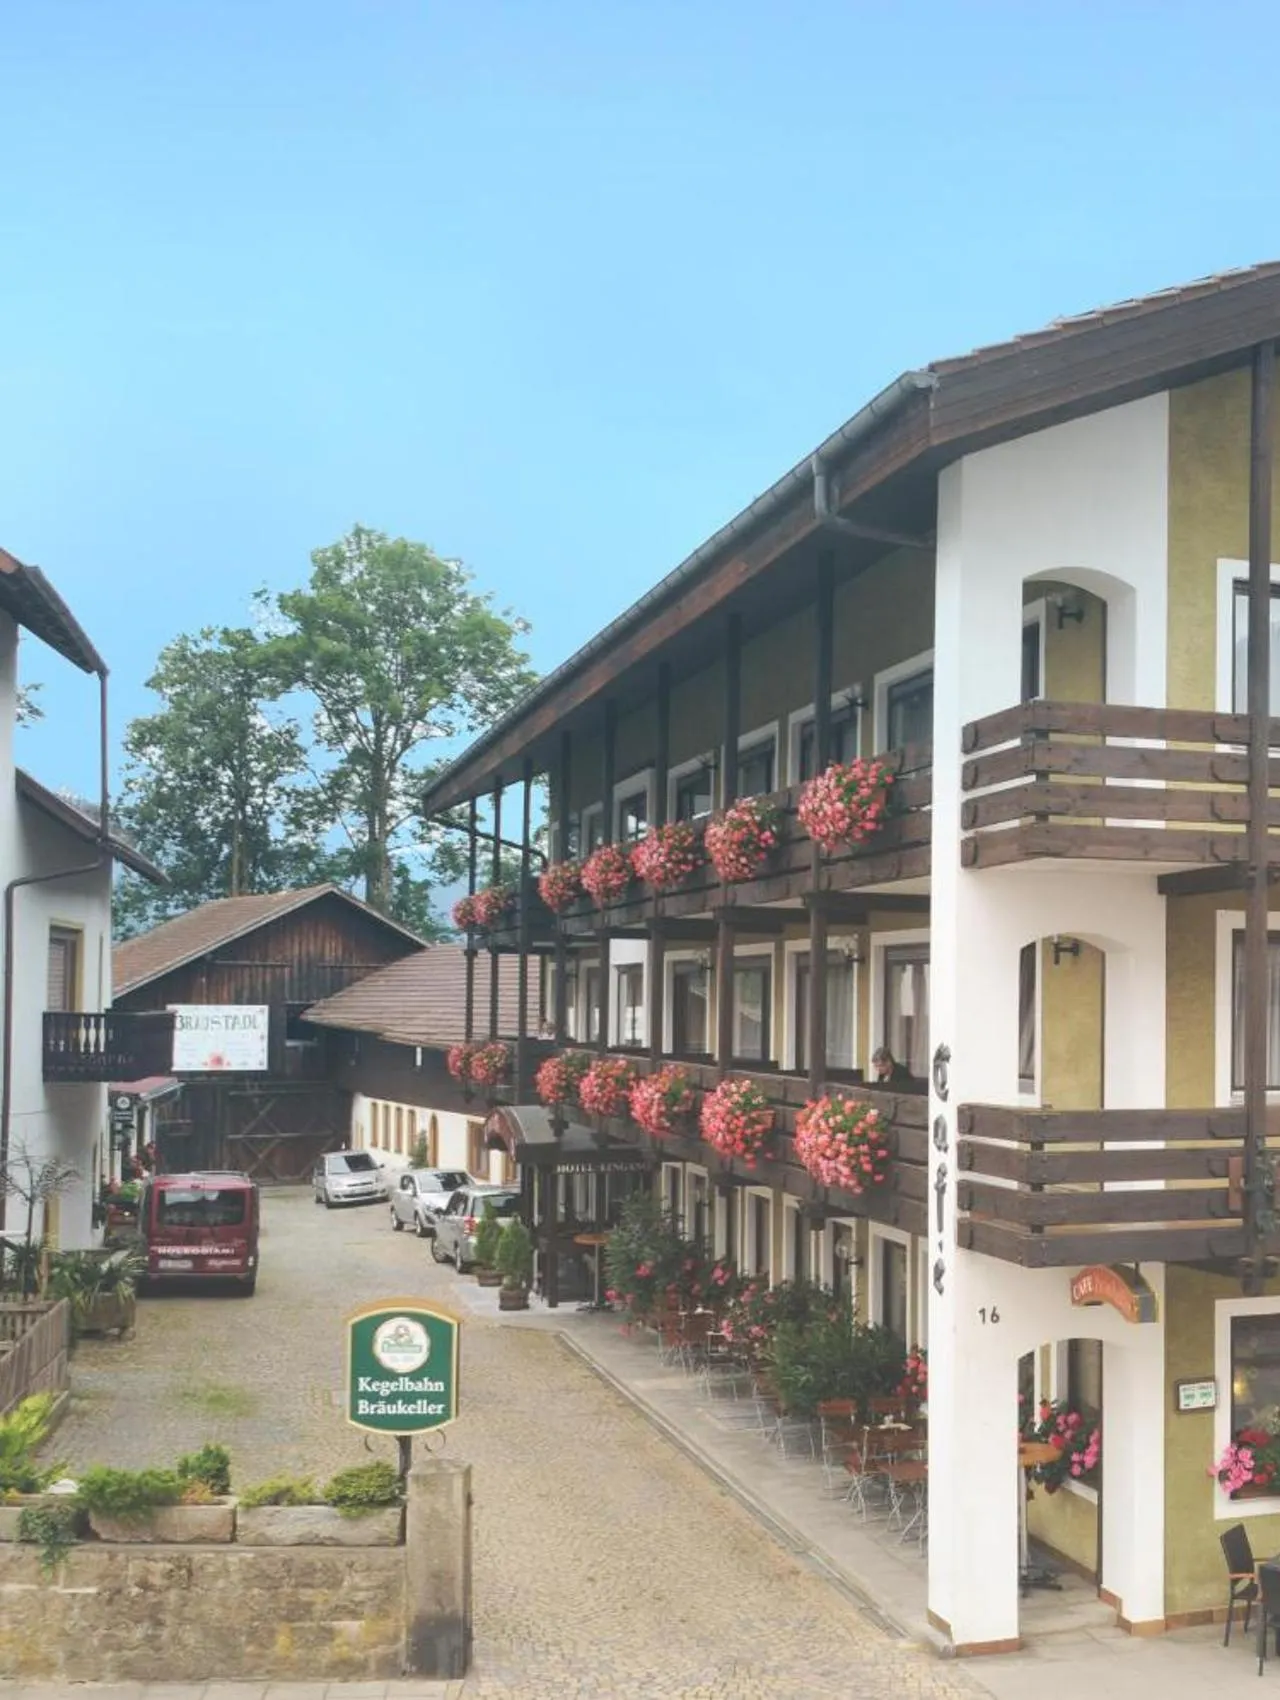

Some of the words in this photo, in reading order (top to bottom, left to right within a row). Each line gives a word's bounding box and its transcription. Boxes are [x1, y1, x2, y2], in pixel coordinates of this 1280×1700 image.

[978, 1306, 1000, 1324] 16
[358, 1376, 445, 1397] Kegelbahn
[358, 1399, 446, 1415] Bräukeller
